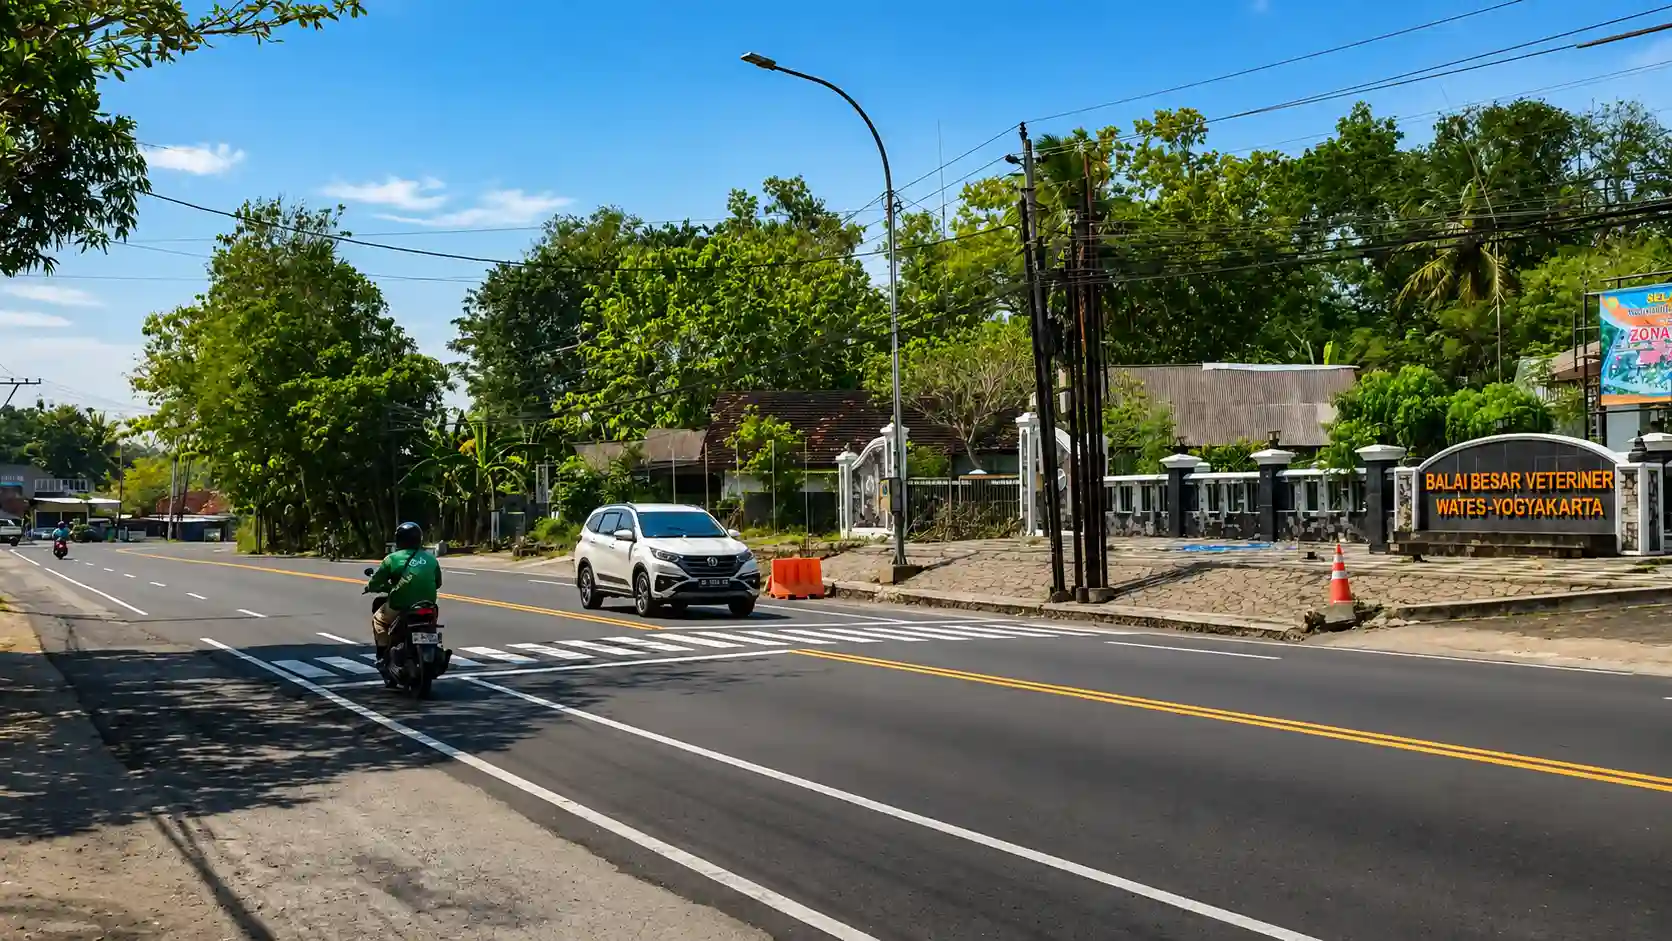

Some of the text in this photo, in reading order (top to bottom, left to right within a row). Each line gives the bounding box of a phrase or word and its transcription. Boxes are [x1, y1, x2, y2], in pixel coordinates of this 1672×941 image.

[1630, 327, 1670, 342] ZONA
[1426, 470, 1614, 491] BALAI BESAR VETERINER
[1436, 497, 1604, 516] WATES-YOGYAKARTA
